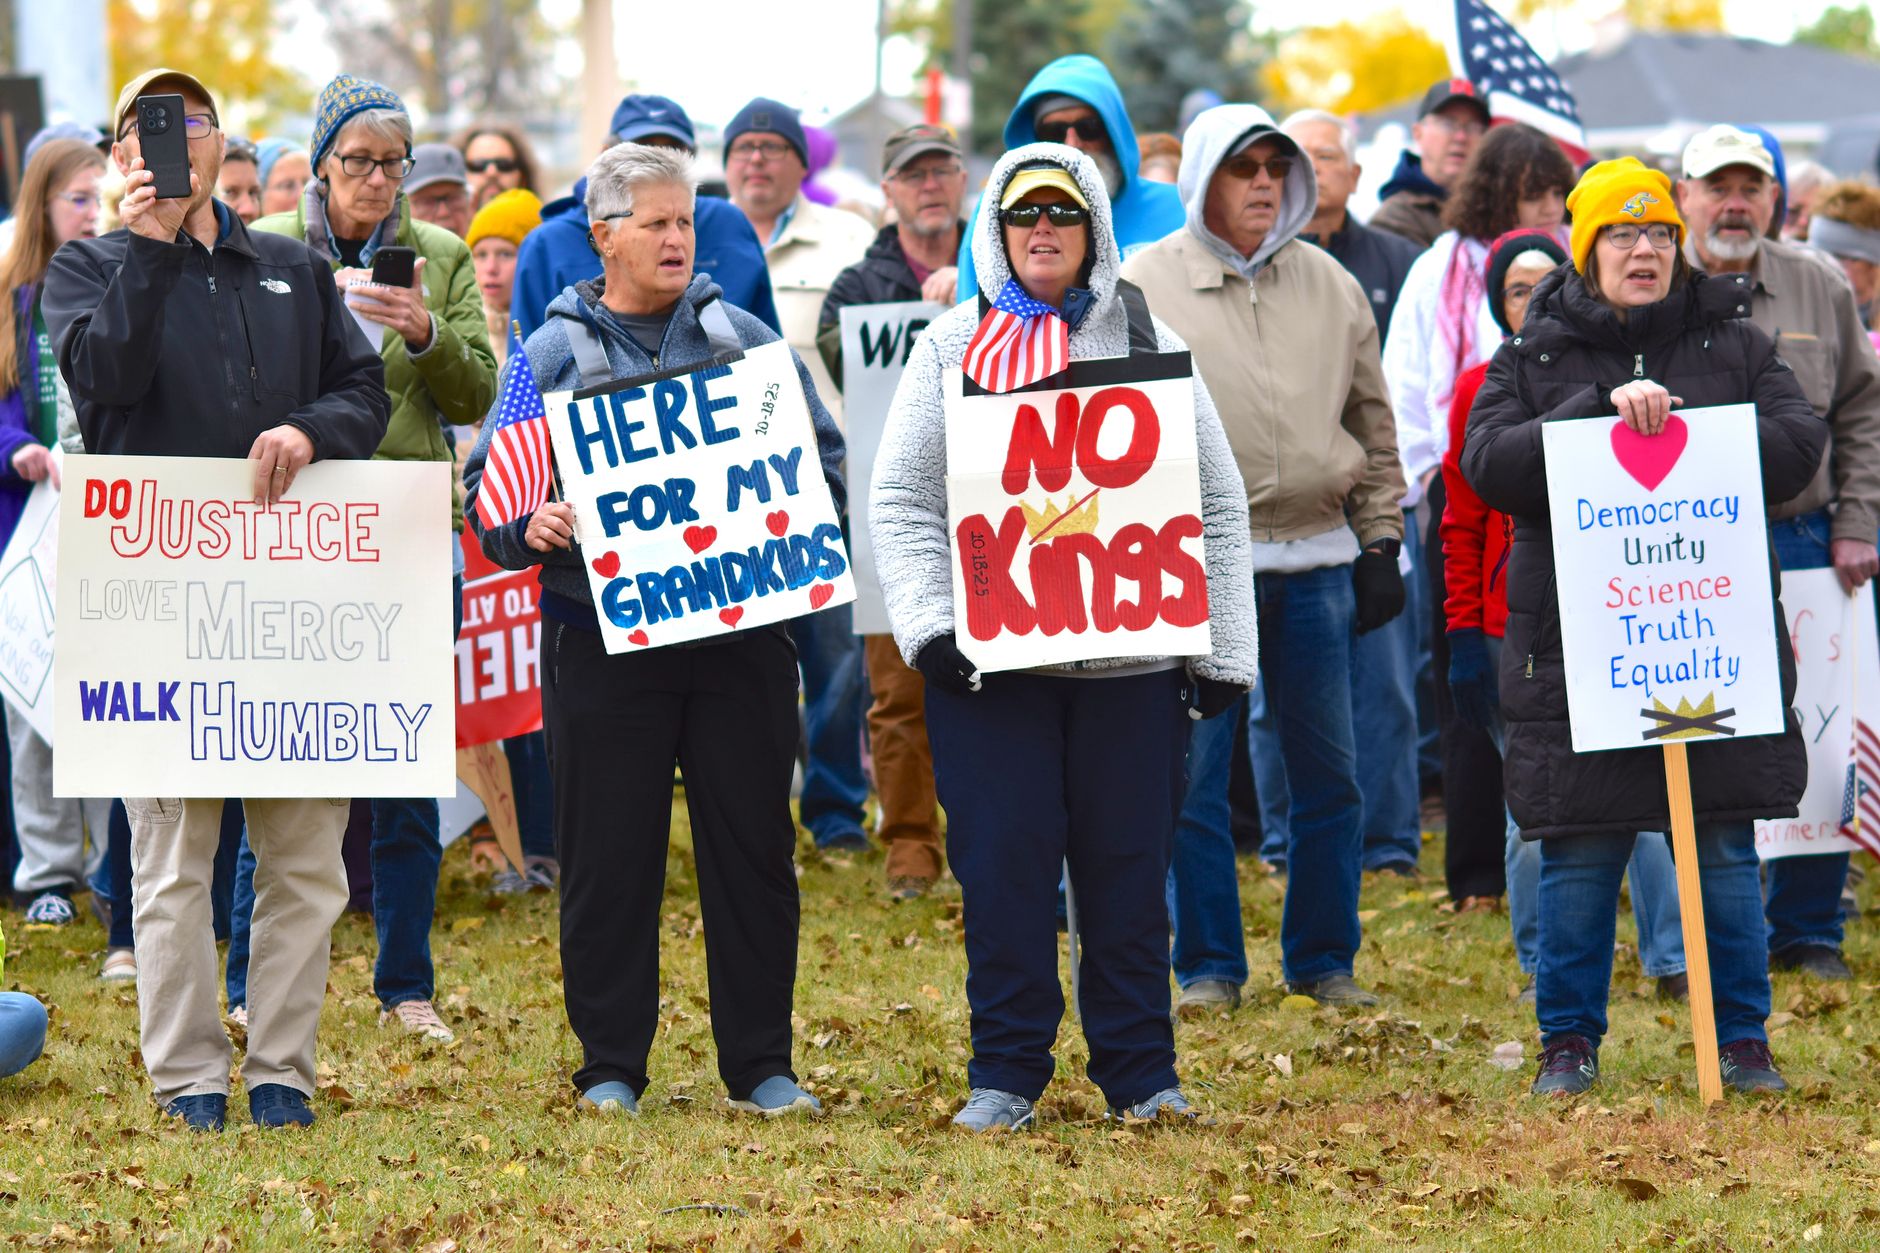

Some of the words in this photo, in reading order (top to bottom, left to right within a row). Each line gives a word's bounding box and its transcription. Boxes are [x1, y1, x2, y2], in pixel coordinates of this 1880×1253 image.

[567, 364, 741, 475] HERE
[1001, 386, 1161, 495] NO
[84, 478, 133, 520] DO
[110, 479, 380, 563] JUSTICE
[596, 477, 700, 538] FOR
[726, 446, 802, 512] MY
[1578, 495, 1740, 531] Democracy
[601, 523, 847, 630] GRANDKIDS
[956, 505, 1210, 642] Kings
[1624, 532, 1706, 566] Unity
[79, 579, 178, 621] LOVE
[185, 580, 403, 662] MERCY
[503, 586, 536, 619] TO
[1606, 575, 1733, 608] Science
[1619, 607, 1716, 647] Truth
[1611, 646, 1741, 698] Equality
[79, 681, 181, 722] WALK
[190, 681, 432, 763] HUMBLY
